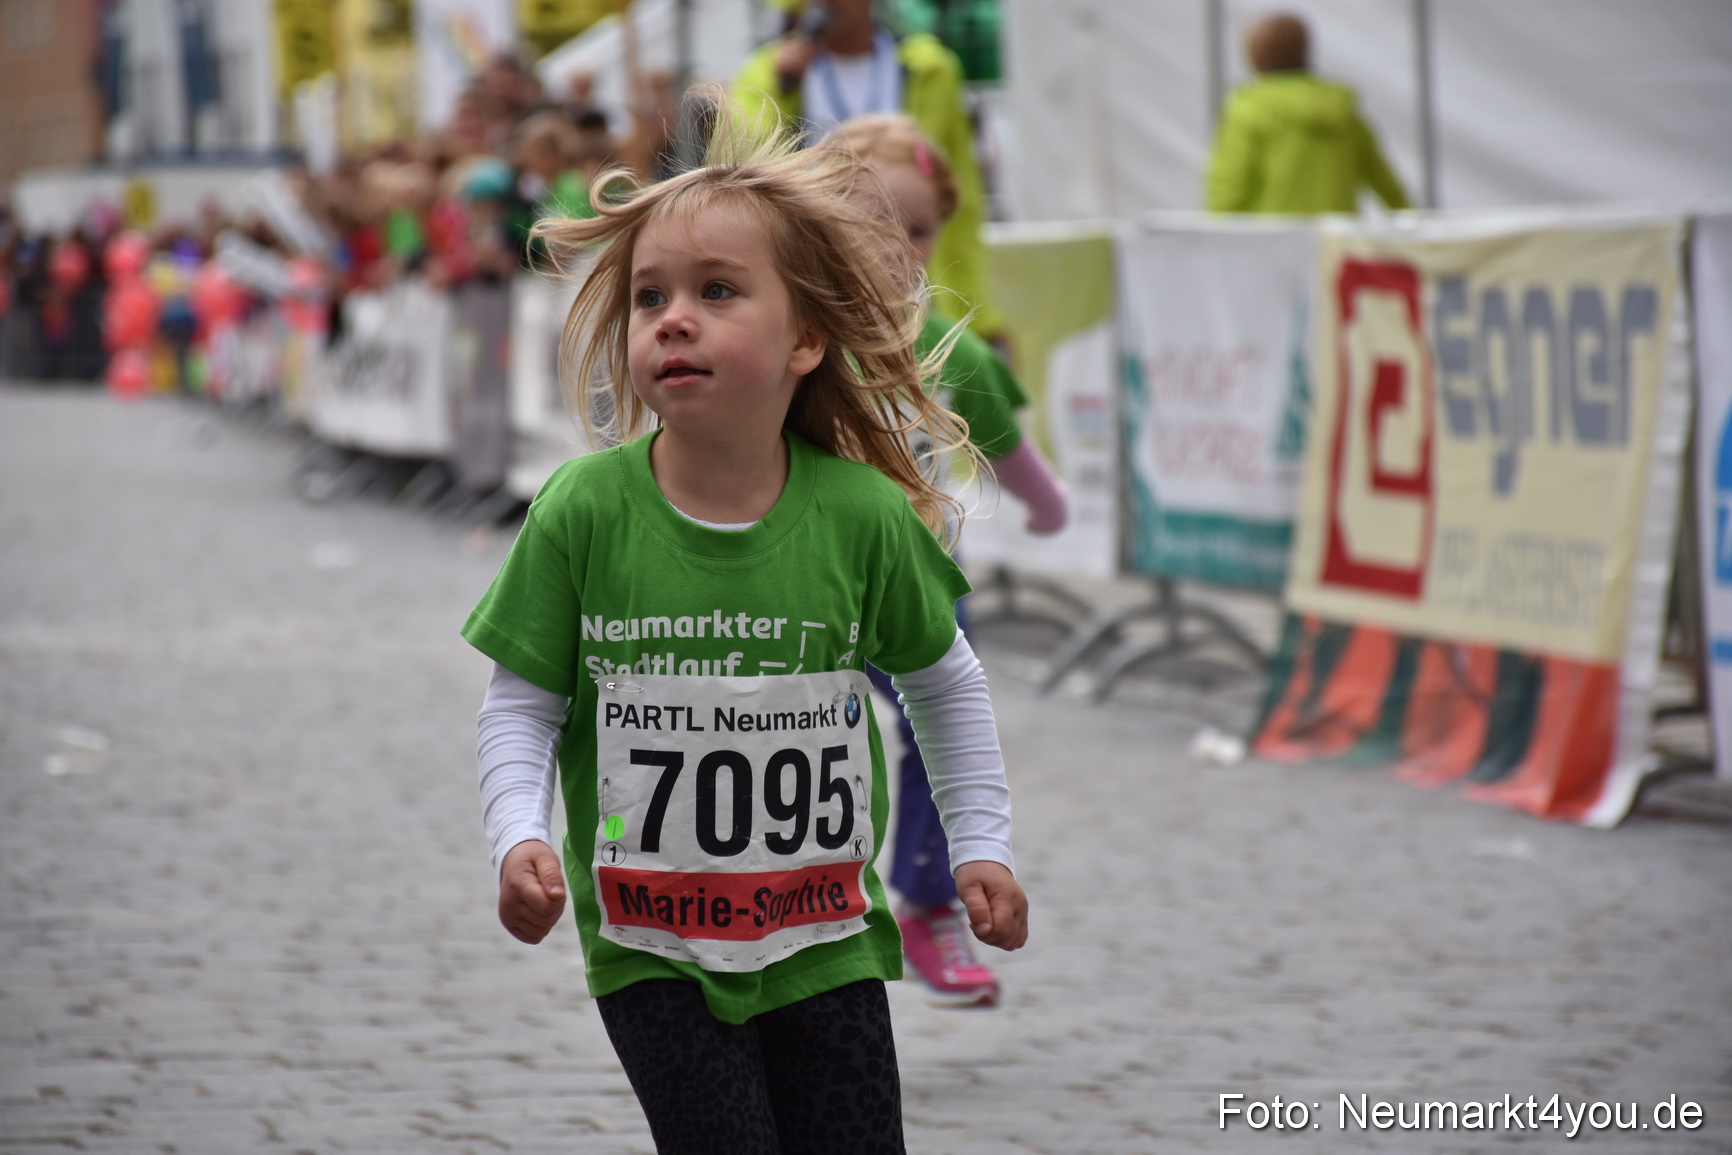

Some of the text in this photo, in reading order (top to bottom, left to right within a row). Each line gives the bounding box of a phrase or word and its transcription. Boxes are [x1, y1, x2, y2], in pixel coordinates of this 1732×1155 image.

[581, 609, 787, 642] Neumarkter
[605, 702, 837, 732] PARTL Neumarkt
[629, 744, 854, 857] 7095
[617, 876, 849, 928] Marie-Sophie
